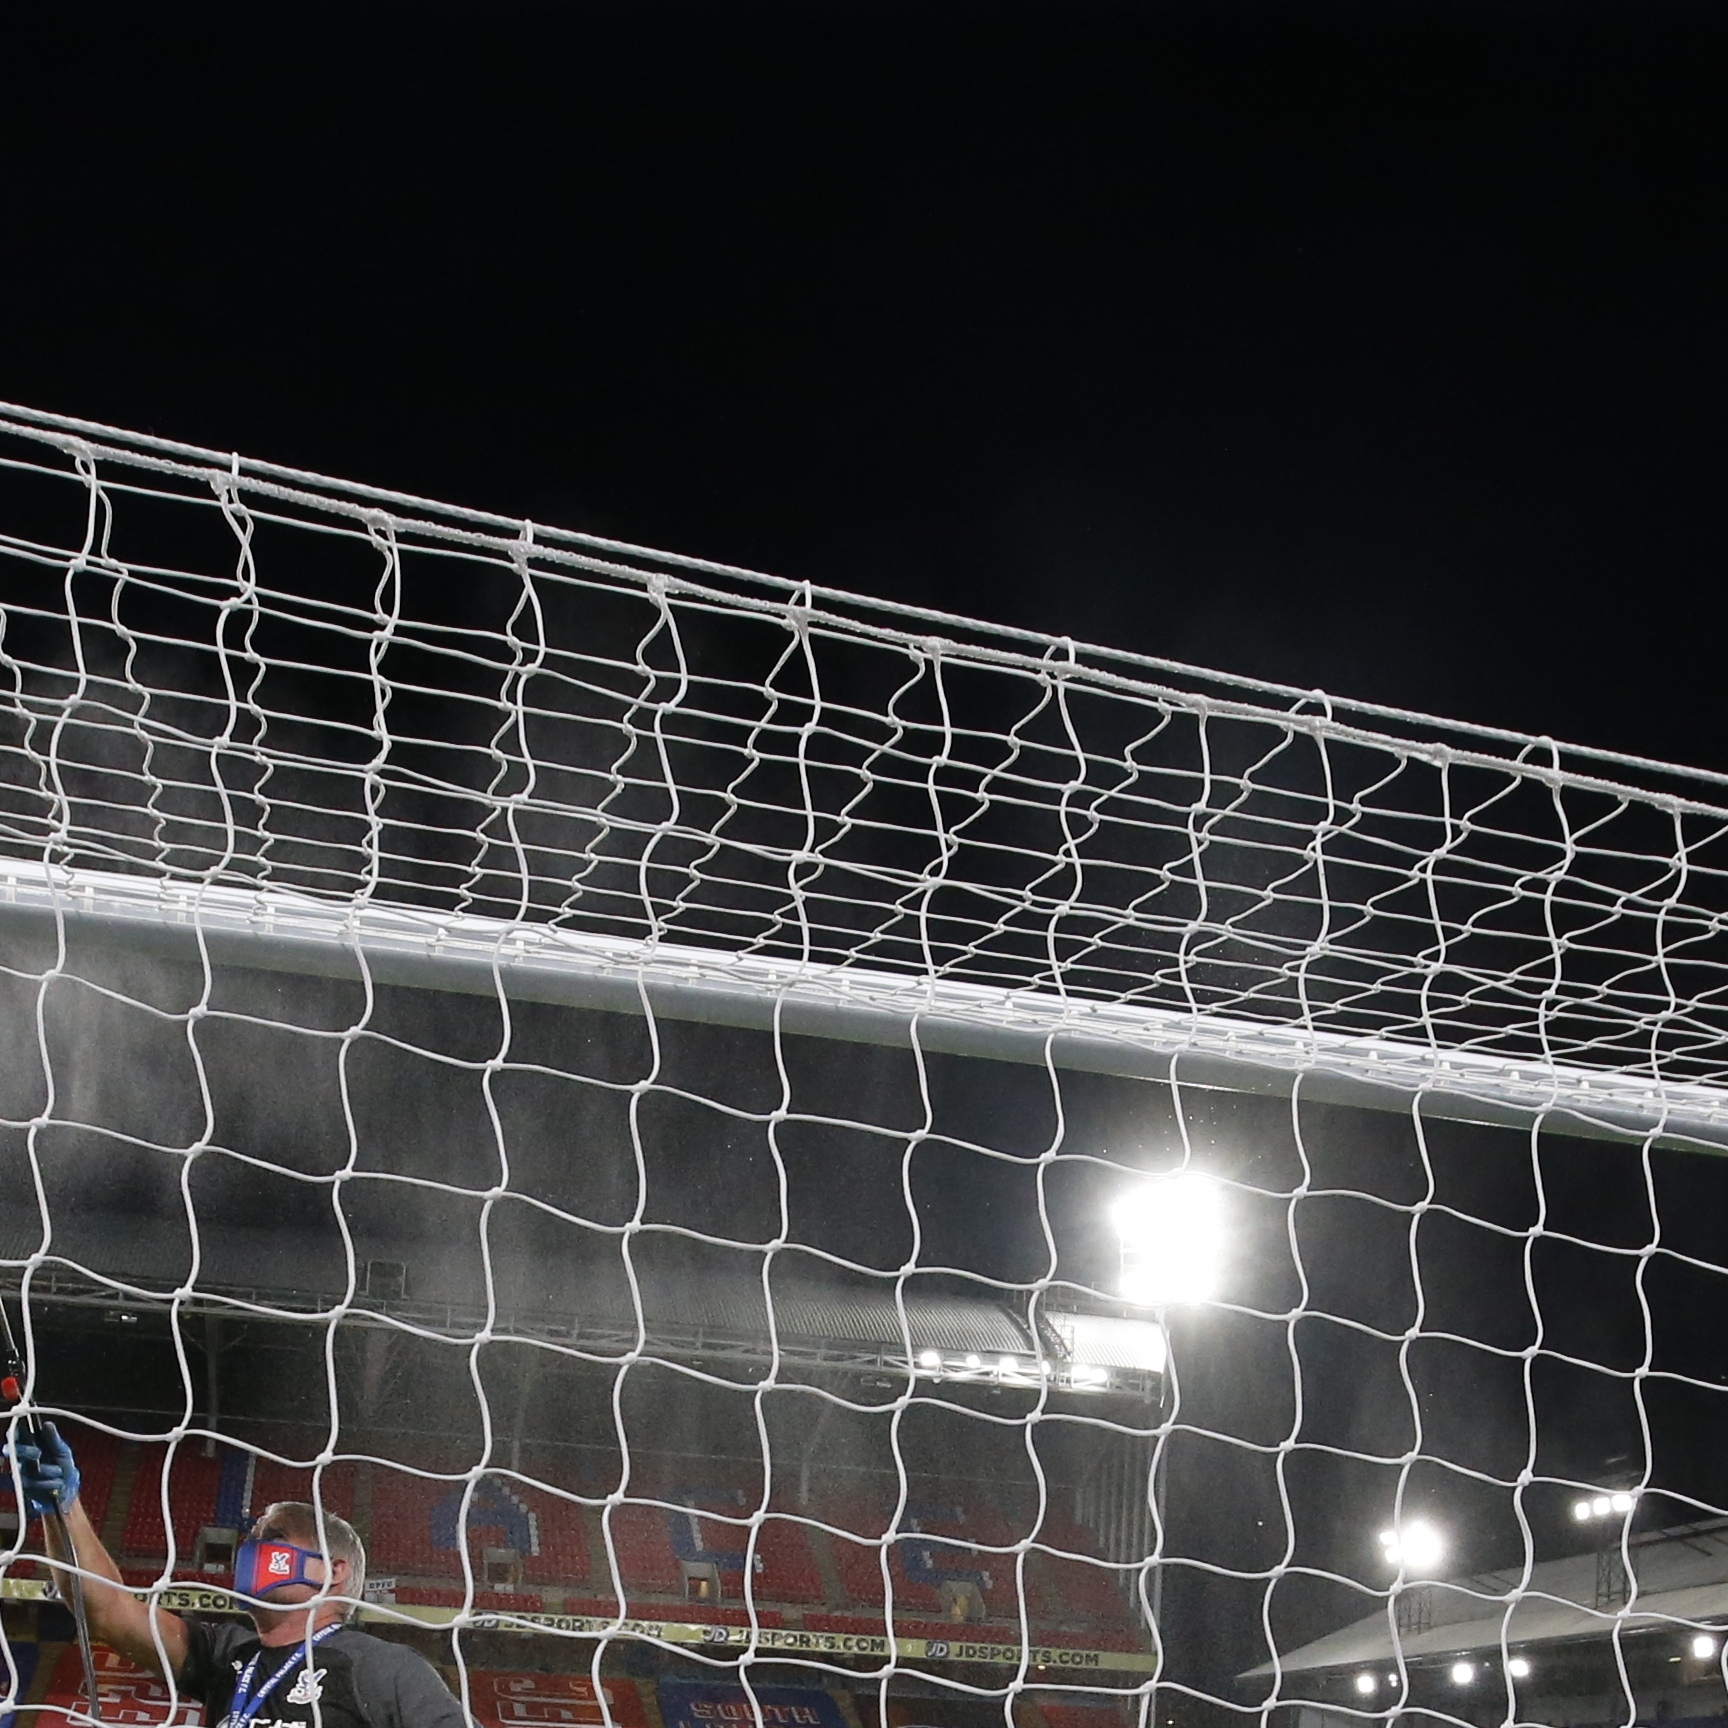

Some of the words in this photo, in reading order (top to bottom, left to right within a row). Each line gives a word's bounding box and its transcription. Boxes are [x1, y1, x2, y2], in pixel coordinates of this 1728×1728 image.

[927, 1641, 950, 1658] JD
[955, 1645, 1100, 1667] JDSPOTS.COM
[689, 1702, 820, 1725] SOUTH
